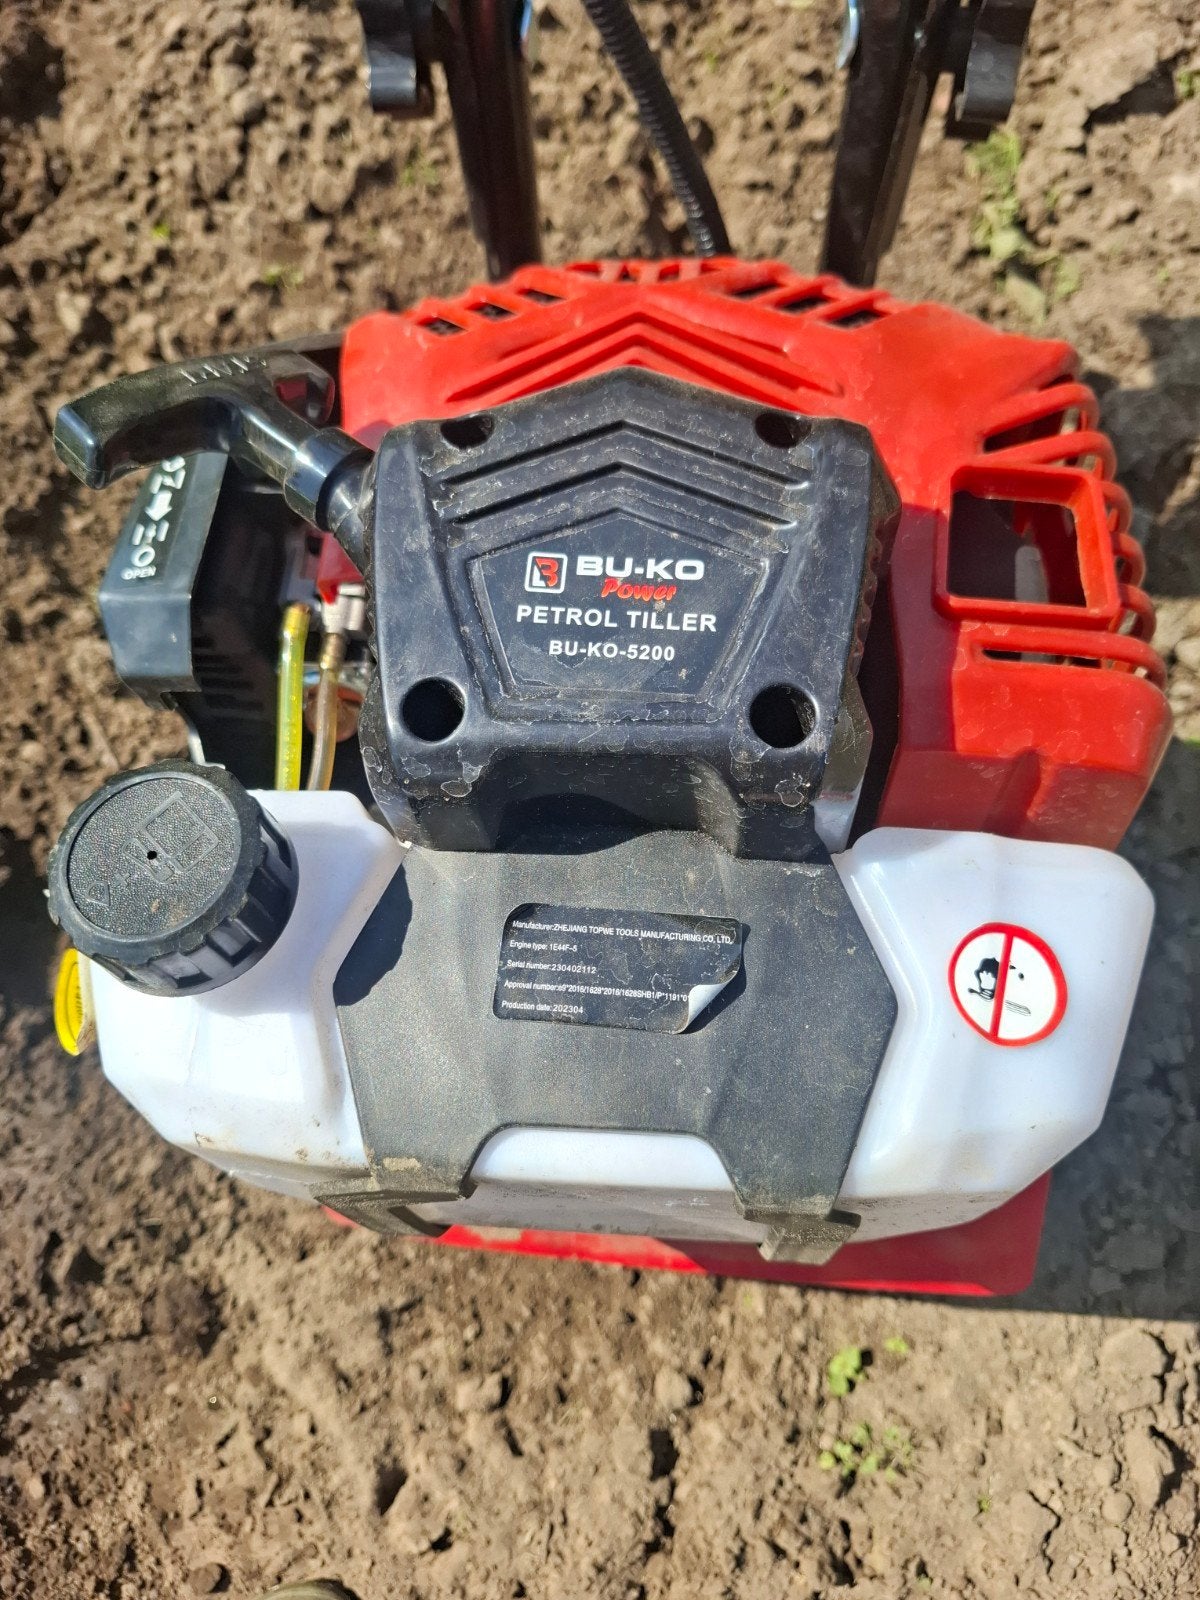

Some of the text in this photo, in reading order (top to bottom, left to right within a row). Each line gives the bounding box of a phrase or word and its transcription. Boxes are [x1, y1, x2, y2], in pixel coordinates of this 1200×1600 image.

[576, 555, 705, 581] BU-KO
[600, 577, 678, 602] Power
[516, 604, 718, 632] PETROL TILLER
[548, 640, 676, 661] BU-KO-5200
[589, 925, 615, 936] TOPWE
[616, 927, 640, 938] TOOLS
[510, 940, 532, 949] Engine
[532, 943, 548, 951] type:
[507, 959, 526, 968] Serial
[504, 980, 532, 990] Approval
[501, 1000, 534, 1010] Production
